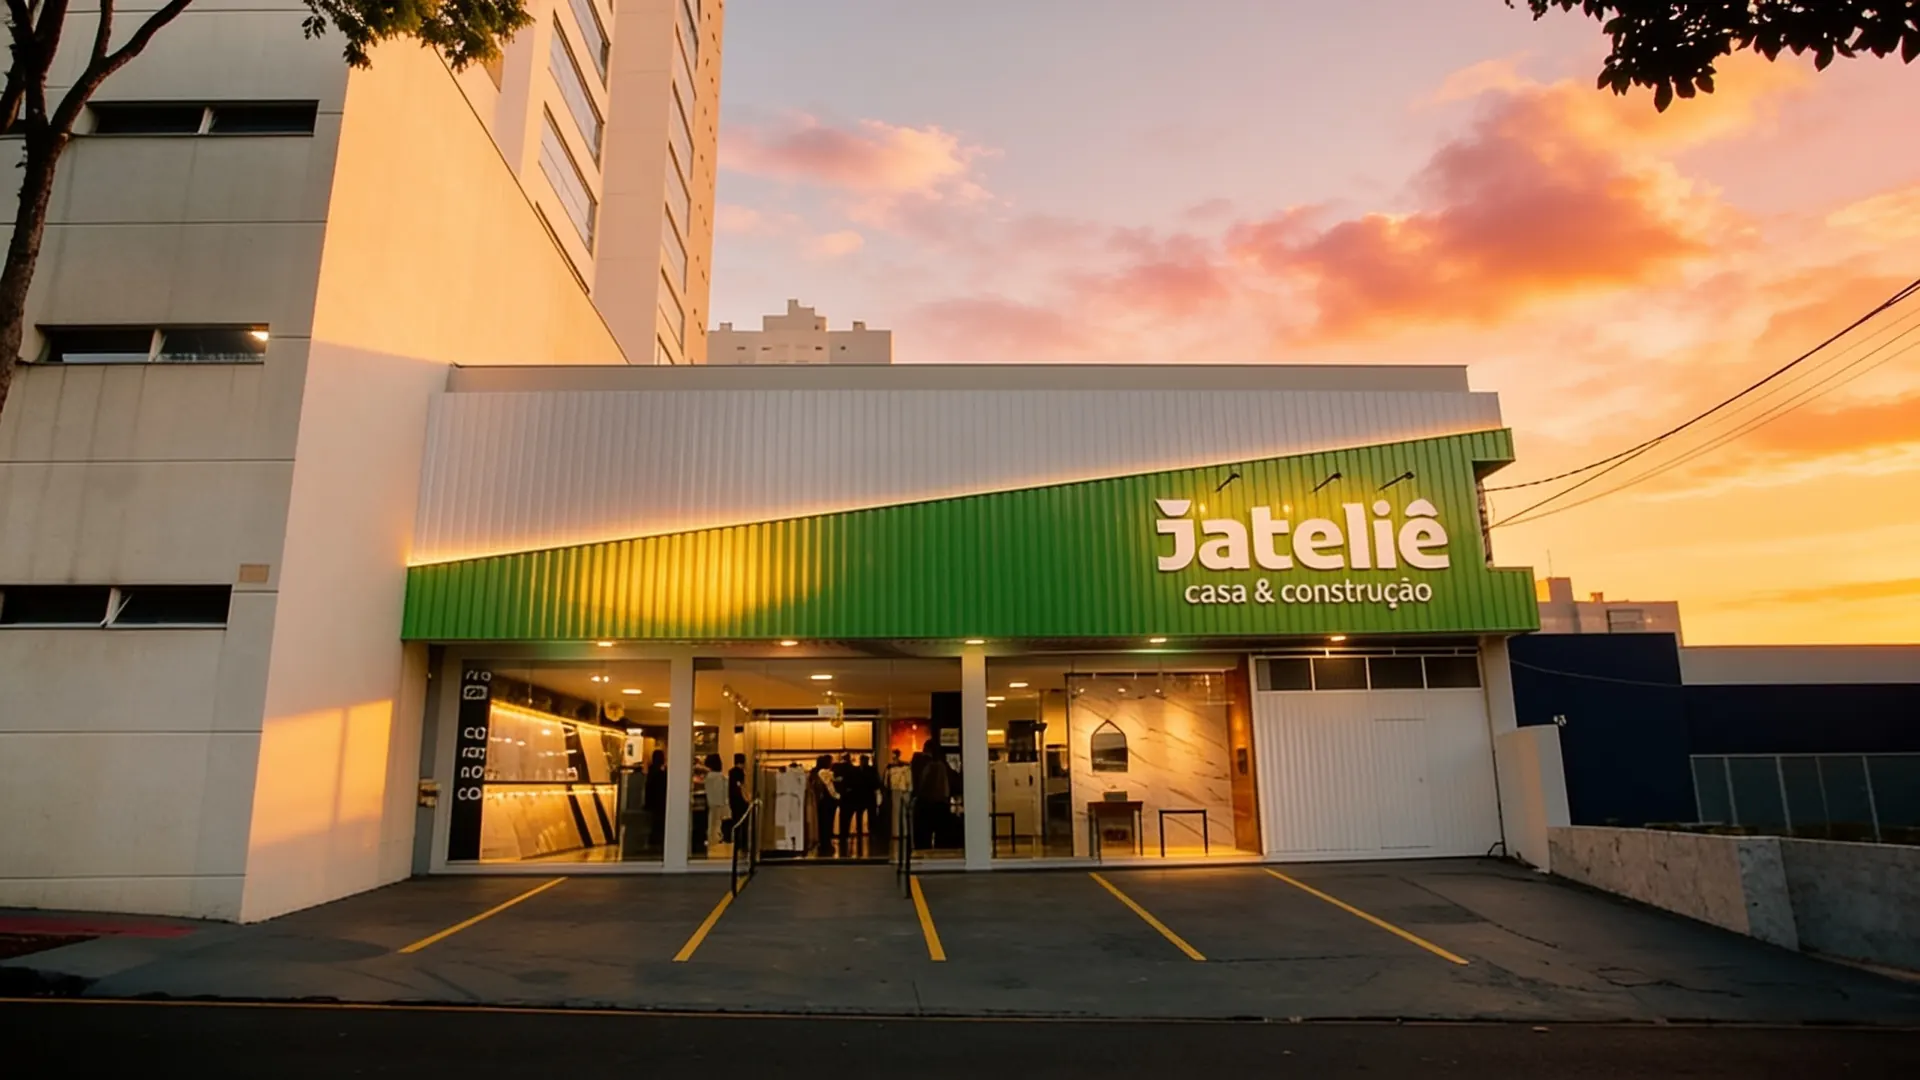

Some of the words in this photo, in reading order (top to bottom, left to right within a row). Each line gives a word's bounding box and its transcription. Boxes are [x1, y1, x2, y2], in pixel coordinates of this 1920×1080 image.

[1185, 583, 1248, 604] casa
[1254, 578, 1275, 604] &
[1281, 577, 1433, 609] construção
